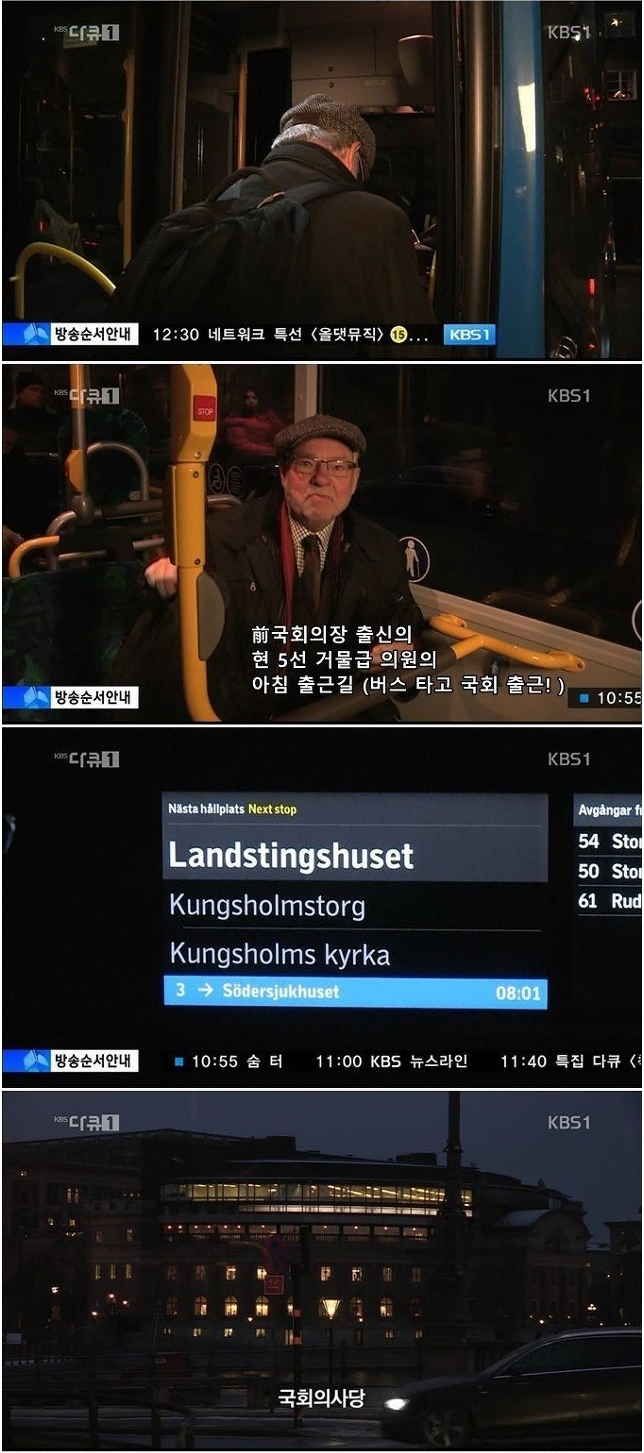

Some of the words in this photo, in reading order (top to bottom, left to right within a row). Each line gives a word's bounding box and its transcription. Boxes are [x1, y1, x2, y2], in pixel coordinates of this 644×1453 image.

[198, 408, 214, 416] STOP
[169, 804, 198, 813] Nästa
[201, 803, 244, 815] hållplats
[249, 804, 272, 814] Next
[275, 805, 296, 816] stop
[579, 804, 632, 817] Avgångar
[579, 834, 599, 848] 54
[170, 841, 413, 874] Landstingshuset
[579, 864, 599, 878] 50
[171, 894, 364, 921] Kungsholmstorg
[579, 894, 597, 908] 61
[171, 942, 315, 968] Kungsholms
[326, 944, 390, 969] kyrka
[176, 983, 186, 997] 3
[222, 982, 340, 1001] Södersjukhuset
[496, 986, 540, 1000] 08:01
